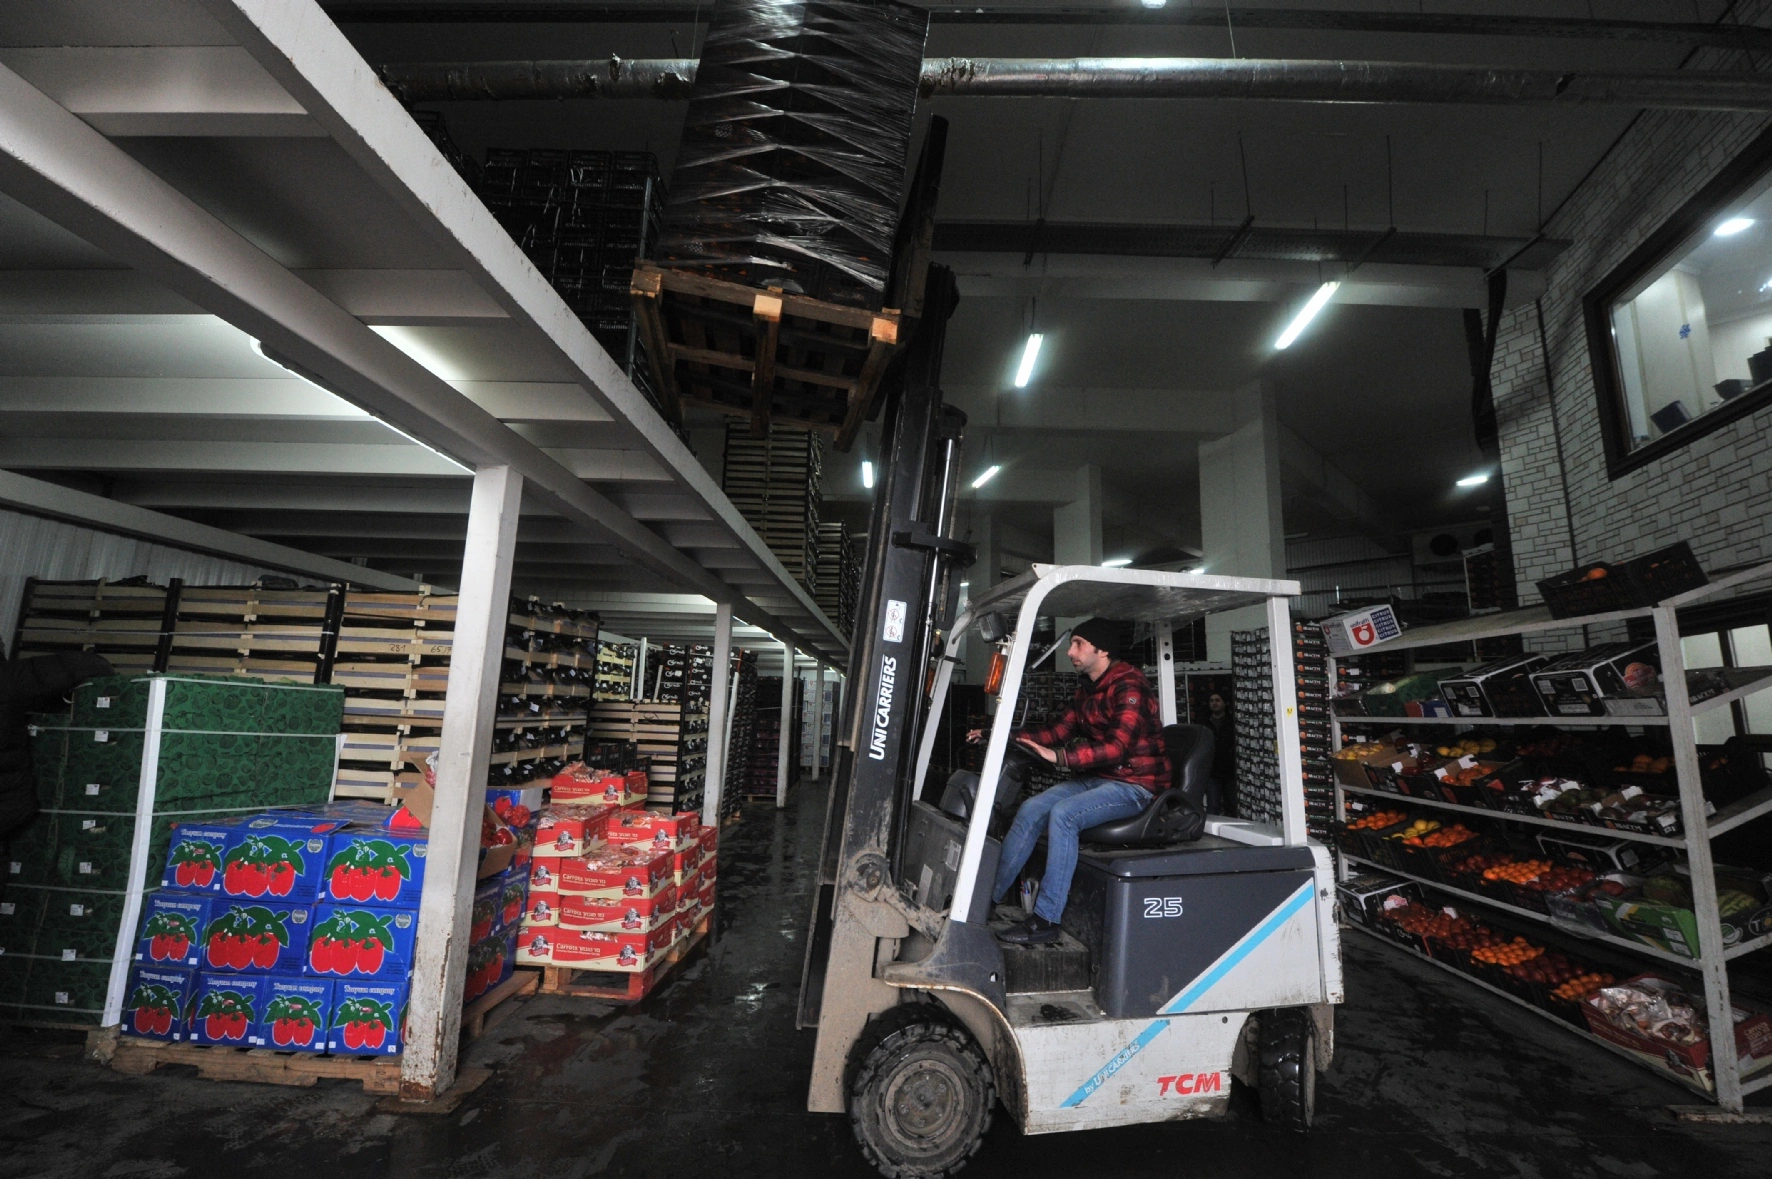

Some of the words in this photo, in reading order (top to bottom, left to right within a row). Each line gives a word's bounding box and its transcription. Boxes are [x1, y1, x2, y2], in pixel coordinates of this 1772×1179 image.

[1372, 610, 1390, 618] CITRUS
[1374, 615, 1392, 623] CITRUS
[1376, 620, 1394, 628] CITRUS
[1378, 625, 1396, 633] CITRUS
[1380, 630, 1398, 638] CITRUS
[869, 654, 896, 760] UNICARRIERS
[203, 832, 227, 840] company
[178, 903, 202, 911] company
[1143, 897, 1183, 918] 25
[564, 908, 582, 916] Carrots
[161, 975, 186, 984] company
[299, 986, 324, 994] company
[369, 988, 396, 996] company
[1156, 1072, 1220, 1096] TCM
[1084, 1083, 1094, 1095] by
